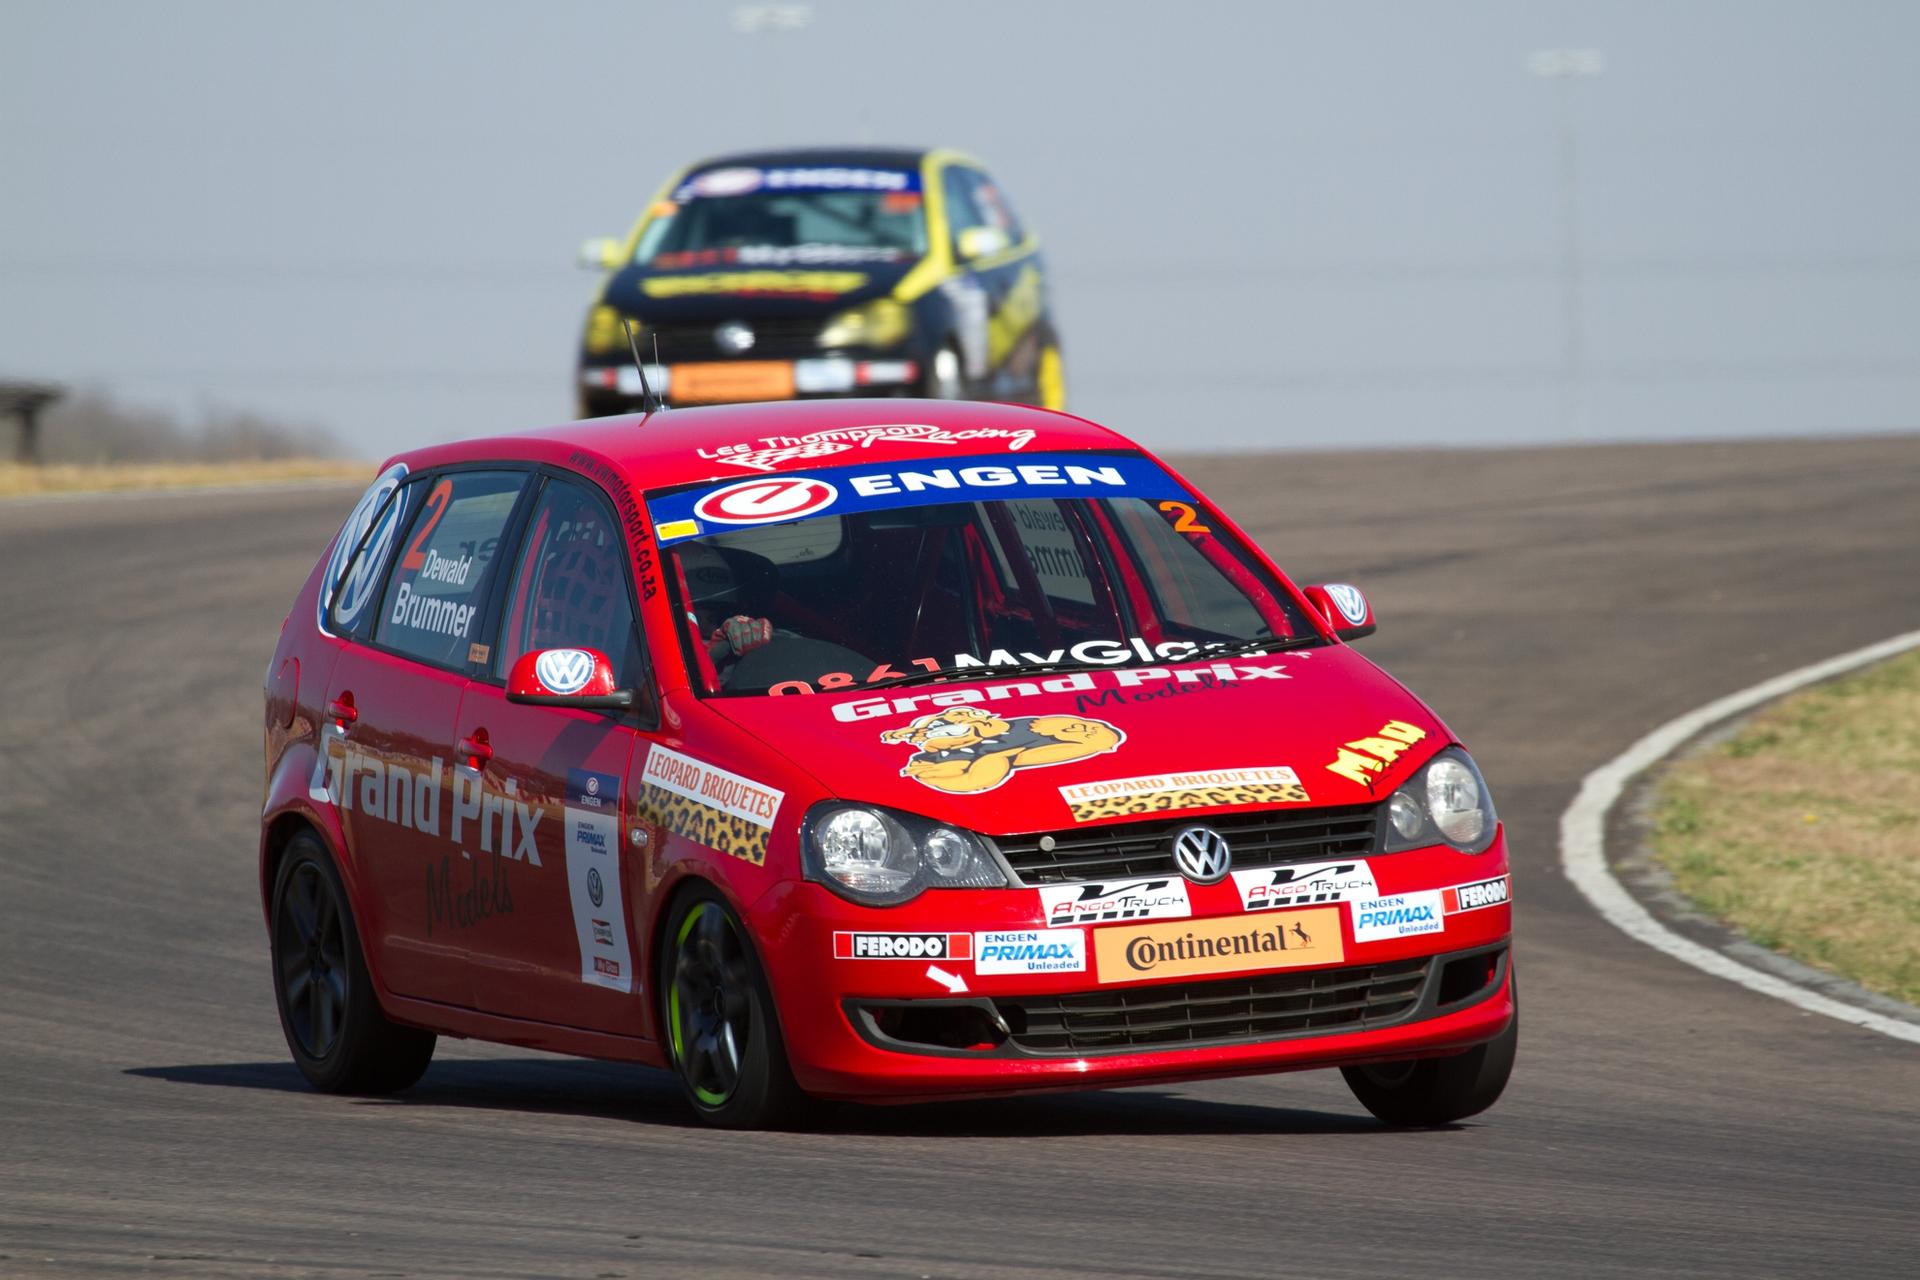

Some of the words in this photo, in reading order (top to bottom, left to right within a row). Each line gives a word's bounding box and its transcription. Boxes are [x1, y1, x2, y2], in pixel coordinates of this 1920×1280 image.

[758, 425, 929, 448] Thompson
[860, 424, 1037, 451] Racing
[849, 465, 1127, 497] ENGEN
[402, 479, 453, 569] 2
[1159, 501, 1211, 533] 2
[422, 549, 472, 585] Dewald
[392, 582, 476, 638] Brummer
[831, 672, 1097, 722] Grand
[1112, 663, 1293, 687] Prix
[1075, 673, 1240, 713] Models
[309, 724, 443, 838] Grand
[450, 763, 545, 867] Prix
[647, 752, 701, 791] LEOPARD
[700, 771, 778, 820] BRIQUETES
[1066, 778, 1171, 799] LEOPARD
[1172, 769, 1291, 787] BRIQUETES
[577, 830, 606, 848] PRIMAX
[426, 836, 513, 938] Models
[1459, 879, 1507, 909] FERODO
[1358, 905, 1434, 929] PRIMAX
[1360, 897, 1405, 910] ENGEN
[985, 933, 1037, 944] ENGEN
[1398, 922, 1439, 934] Unleaded
[856, 936, 944, 957] FERODO
[980, 943, 1075, 962] PRIMAX
[1126, 925, 1287, 971] Continental
[1027, 960, 1079, 970] Unleaded
